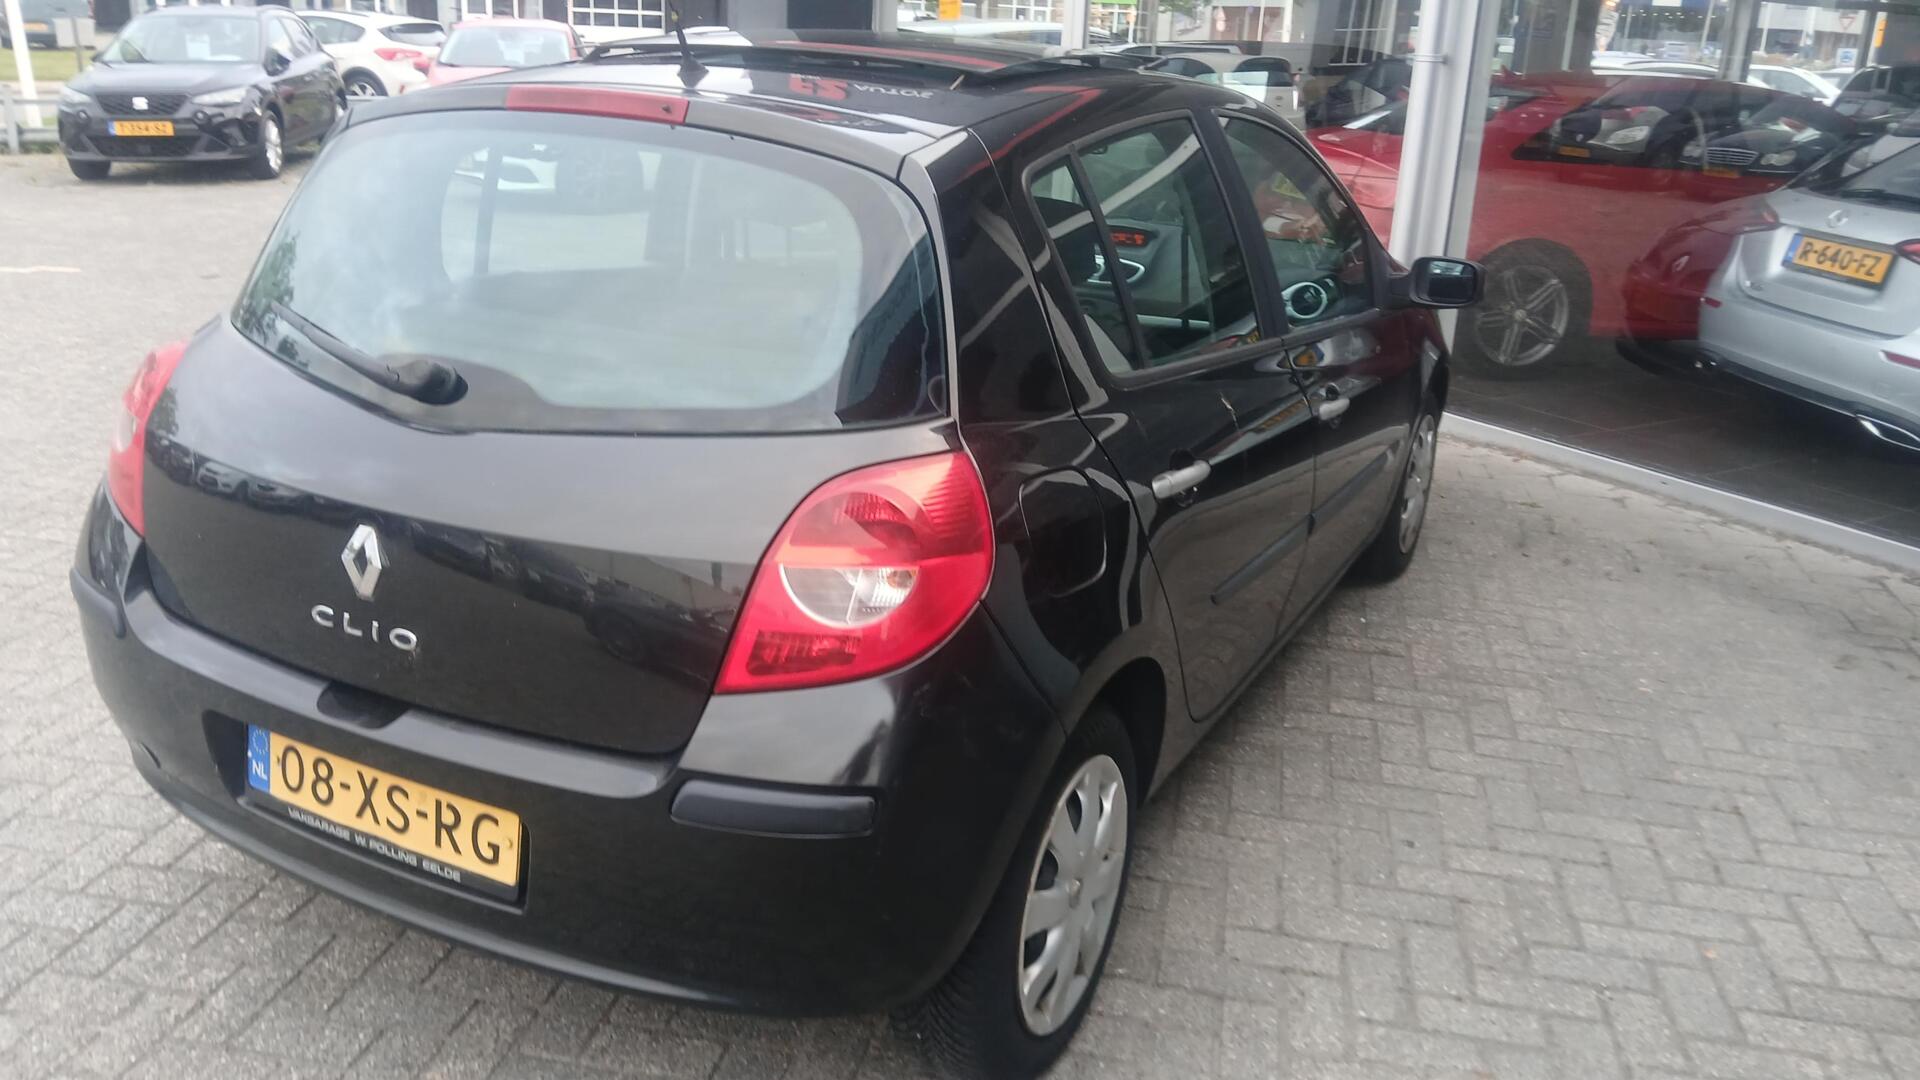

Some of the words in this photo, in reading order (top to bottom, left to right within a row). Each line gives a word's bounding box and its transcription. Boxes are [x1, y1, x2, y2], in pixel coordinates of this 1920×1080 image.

[1799, 241, 1882, 277] R-640-FZ
[311, 604, 418, 651] CLIO
[252, 759, 268, 781] NL
[281, 745, 500, 866] 08-XS-RG
[369, 840, 417, 868] POLLING
[422, 858, 461, 883] EELDE
